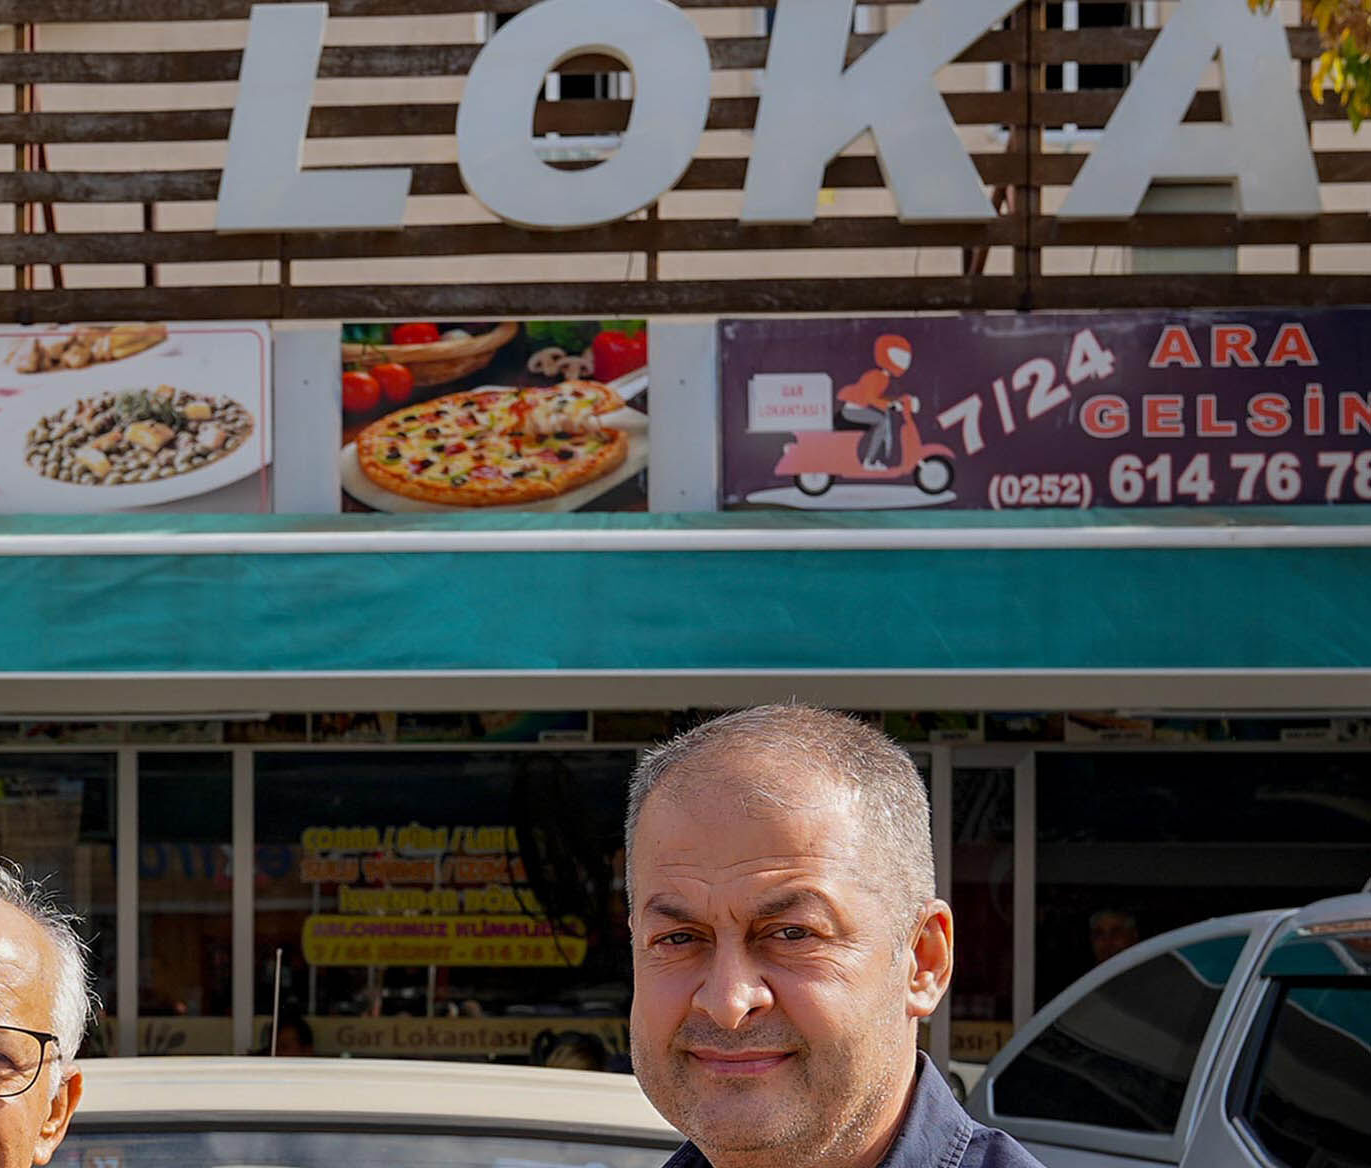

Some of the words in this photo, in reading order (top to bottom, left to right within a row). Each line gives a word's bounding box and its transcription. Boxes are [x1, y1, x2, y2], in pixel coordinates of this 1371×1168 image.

[1149, 323, 1319, 368] ARA
[937, 328, 1115, 455] 7/24
[987, 473, 1092, 509] (0252)
[1109, 452, 1215, 503] 614
[1230, 452, 1301, 503] 76
[335, 1026, 383, 1049] Gar
